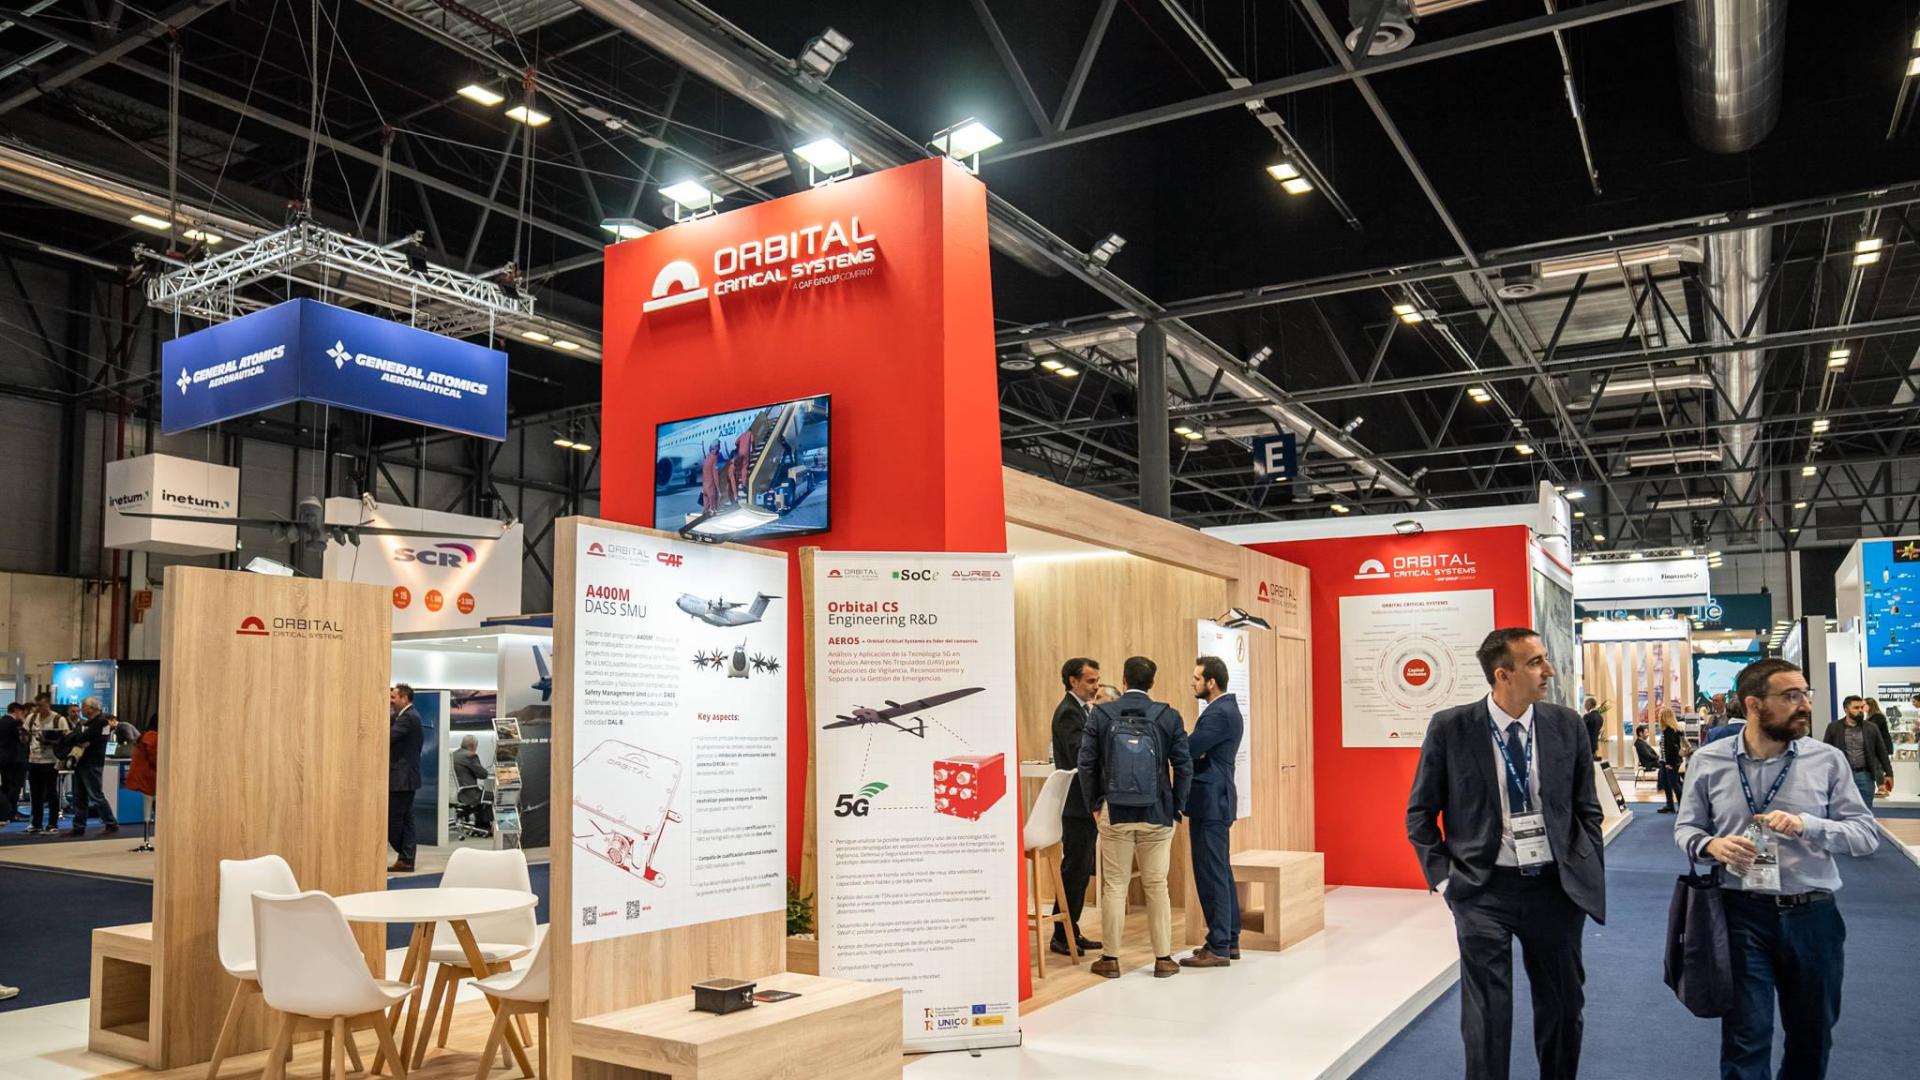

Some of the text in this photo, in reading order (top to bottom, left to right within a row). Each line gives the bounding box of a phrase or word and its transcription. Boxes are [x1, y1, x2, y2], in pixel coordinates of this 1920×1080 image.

[714, 216, 876, 276] ORBITAL
[714, 248, 876, 296] CRITICAL SYSTEMS
[799, 278, 813, 290] CAF
[813, 274, 840, 286] GROUP
[840, 267, 874, 280] COMPANY
[193, 345, 286, 384] GENERAL ATOMICS
[209, 366, 264, 389] AERONAUTICAL
[355, 353, 488, 395] GENERAL ATOMICS
[381, 373, 462, 399] AERONAUTICAL
[718, 426, 736, 438] A321
[1265, 441, 1285, 474] E
[395, 548, 462, 568] SCR
[608, 544, 649, 558] ORBITAL
[657, 552, 683, 567] CAF
[1393, 553, 1476, 569] ORBITAL
[1394, 567, 1476, 578] CRITICAL SYSTEMS
[586, 584, 630, 601] A400M
[1270, 583, 1296, 601] ORBITAL
[585, 599, 647, 618] DASS SMU
[828, 601, 899, 612] Orbital CS
[273, 617, 343, 632] ORBITAL
[828, 613, 938, 627] Engineering R&D
[698, 712, 740, 723] Key aspects:
[834, 793, 869, 818] 5G
